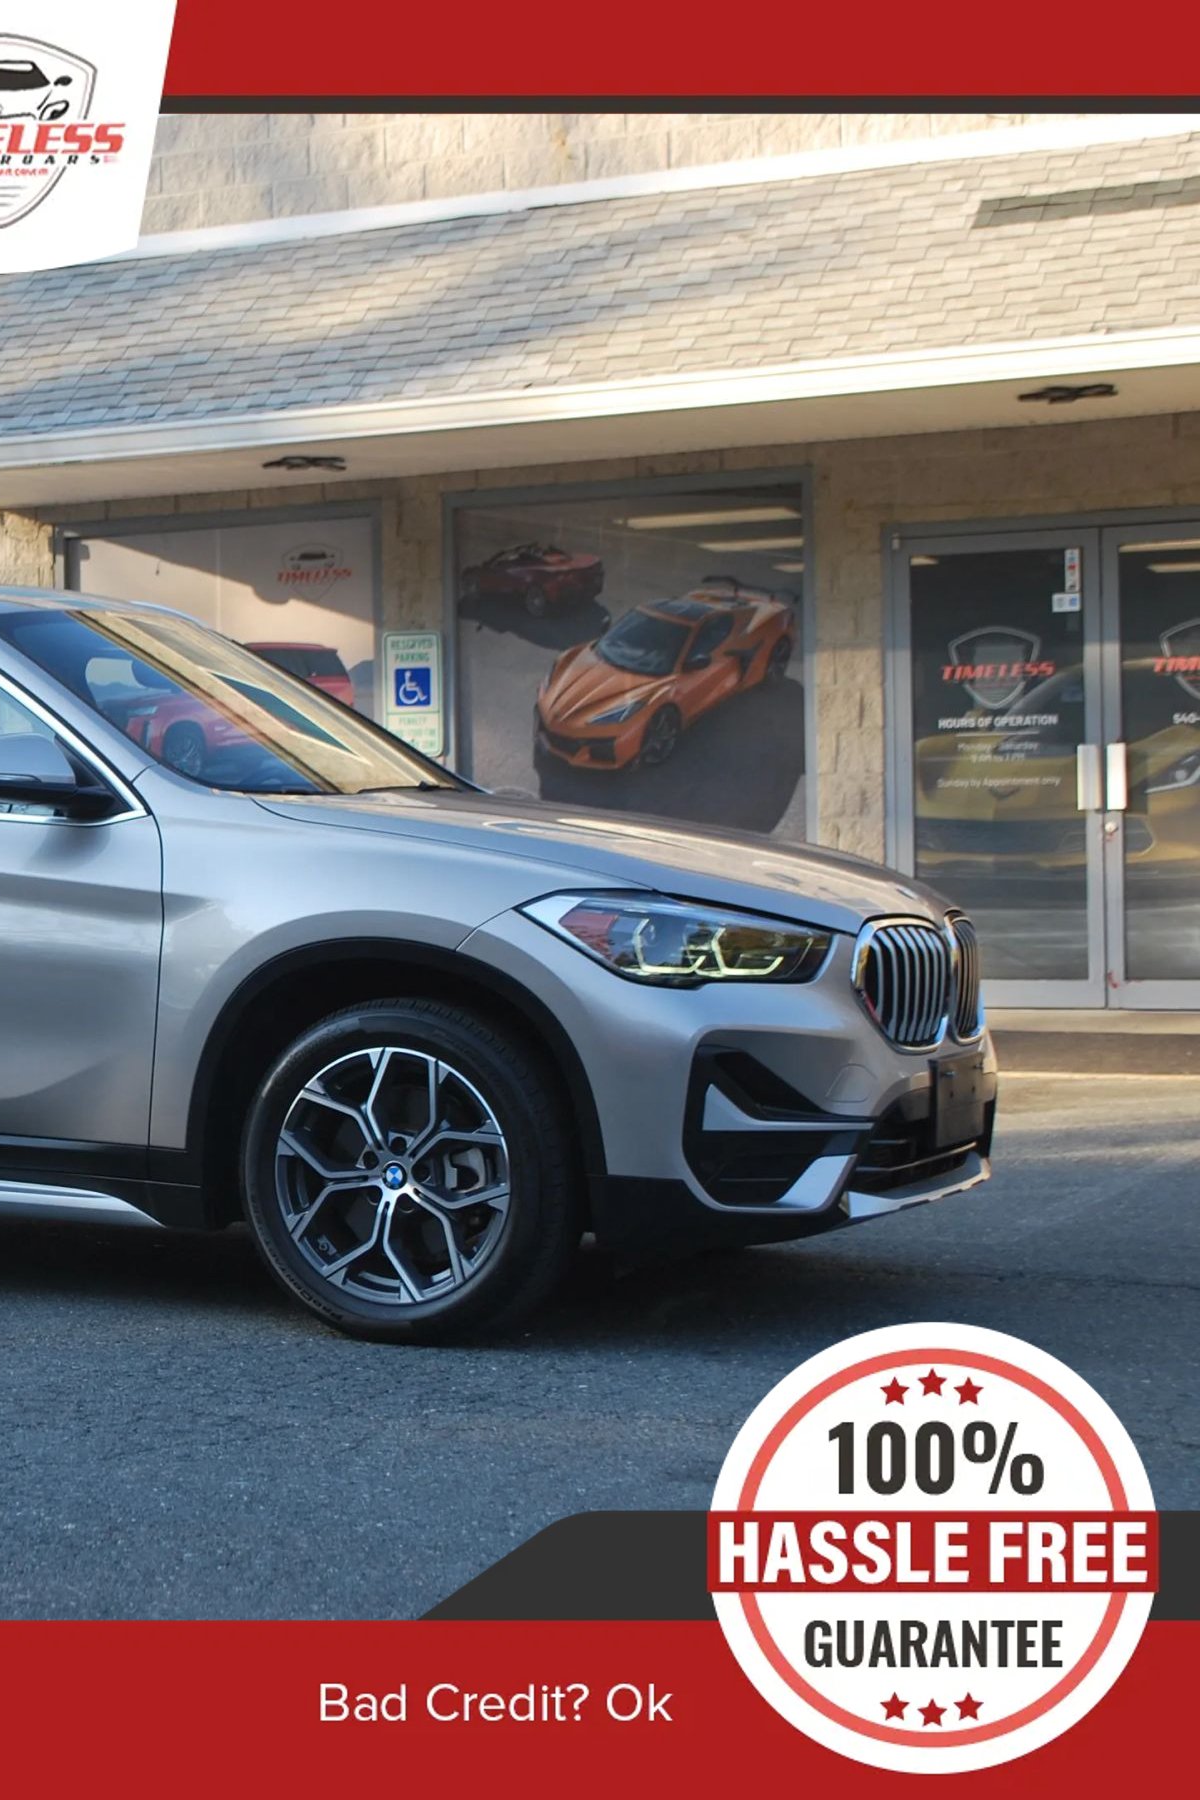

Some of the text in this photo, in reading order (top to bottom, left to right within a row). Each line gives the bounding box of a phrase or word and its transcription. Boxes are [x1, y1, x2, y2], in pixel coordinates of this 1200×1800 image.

[394, 652, 430, 662] PARKING
[942, 662, 1055, 681] TIMELESS
[938, 714, 1059, 729] HOURS OF OPERATION
